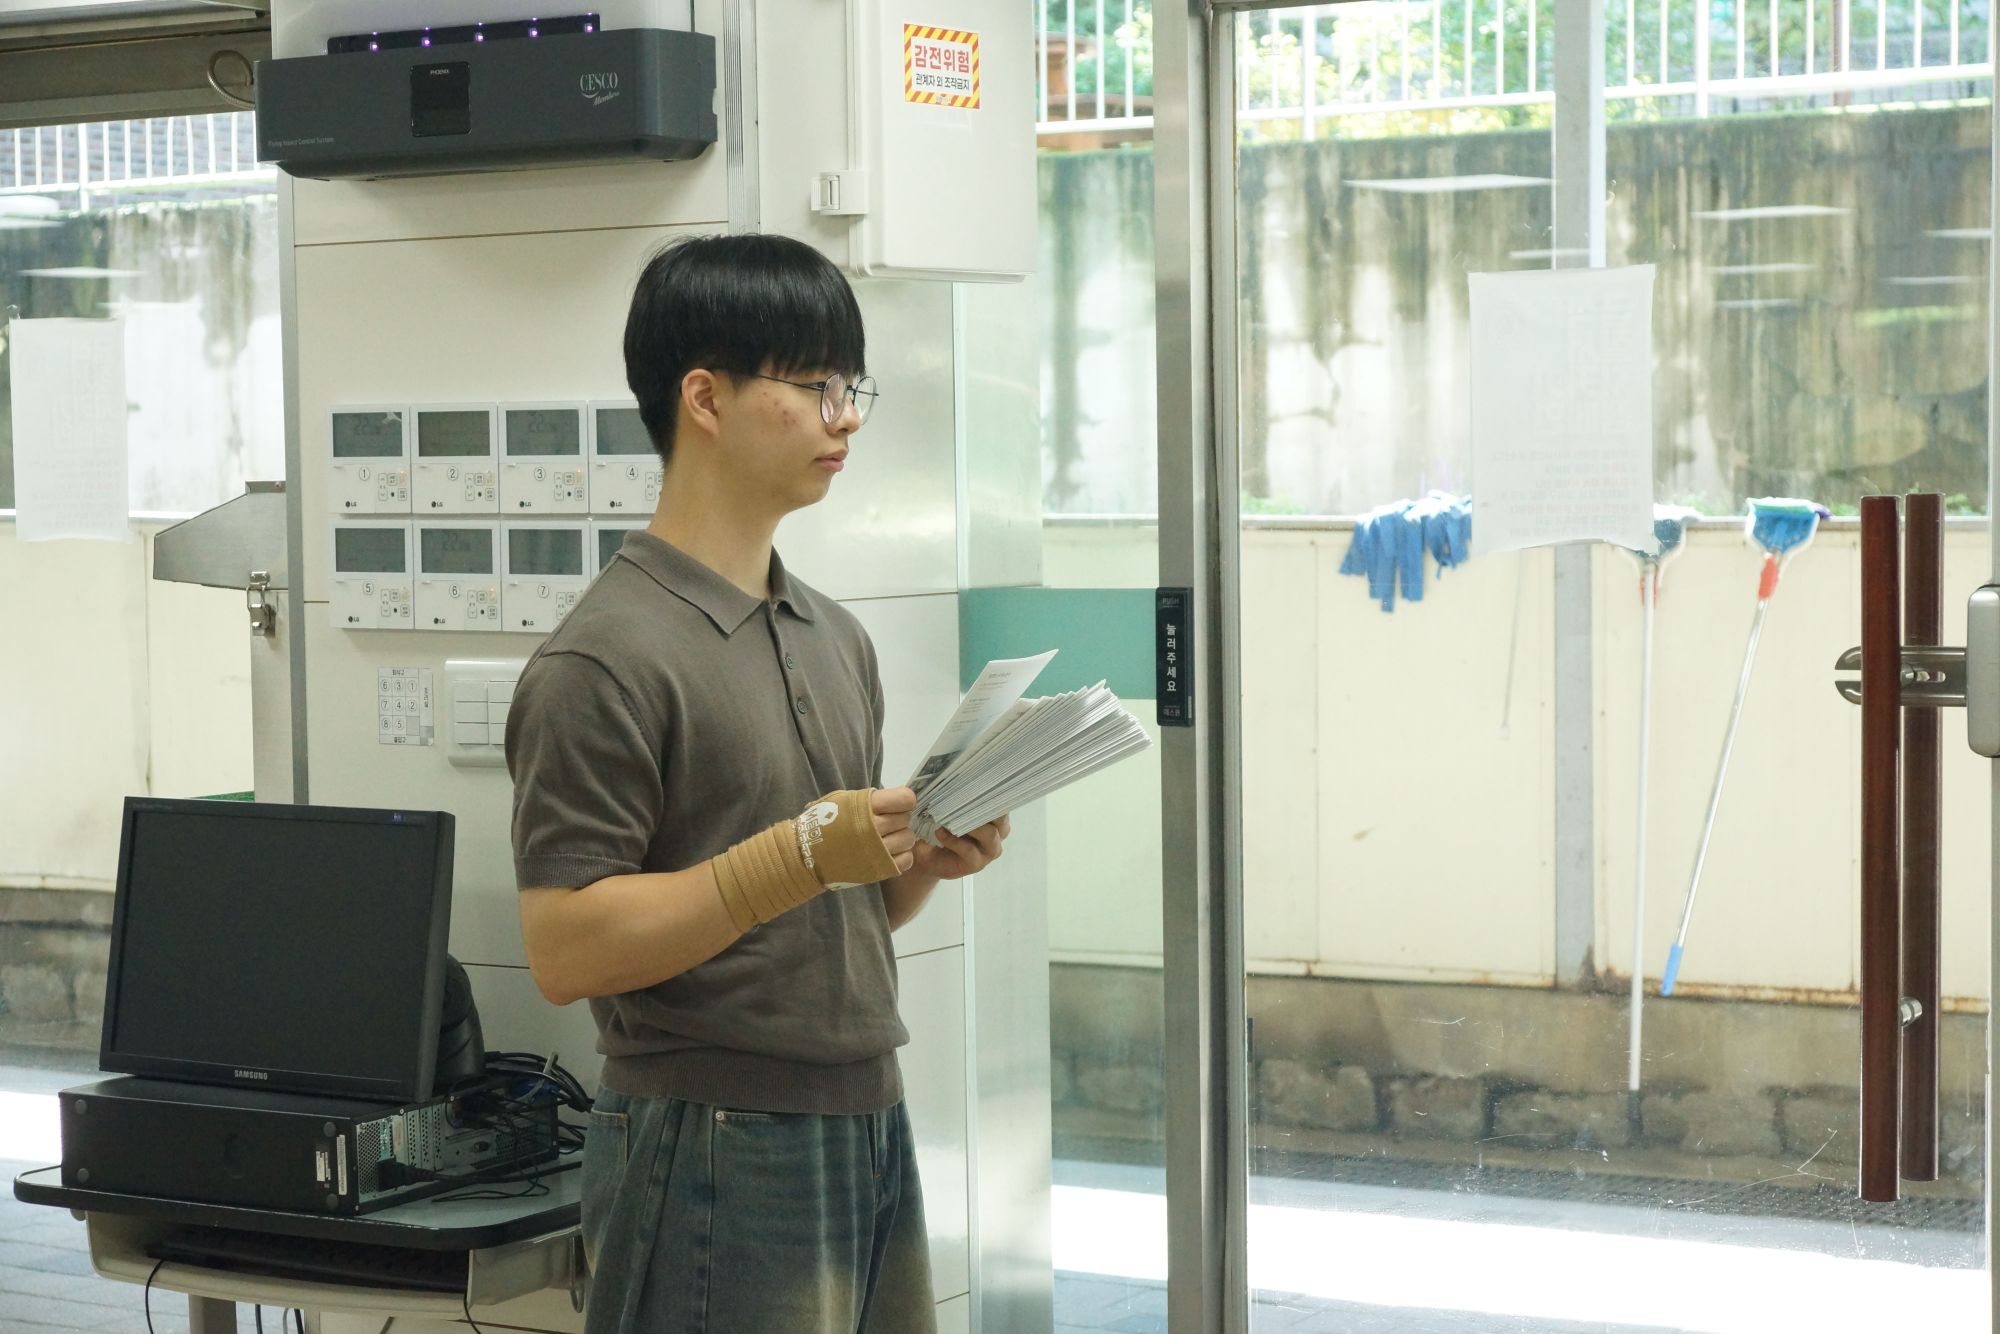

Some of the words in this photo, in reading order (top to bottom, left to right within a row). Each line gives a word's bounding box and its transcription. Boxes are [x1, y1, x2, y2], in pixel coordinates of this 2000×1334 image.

[914, 45, 970, 73] 감전위험
[580, 72, 618, 94] CESCO
[916, 73, 935, 87] 관계자
[936, 75, 943, 87] 외
[944, 77, 970, 91] 조작금지
[1166, 624, 1176, 692] 눌러주세요
[234, 1069, 268, 1080] SAMSUNG
